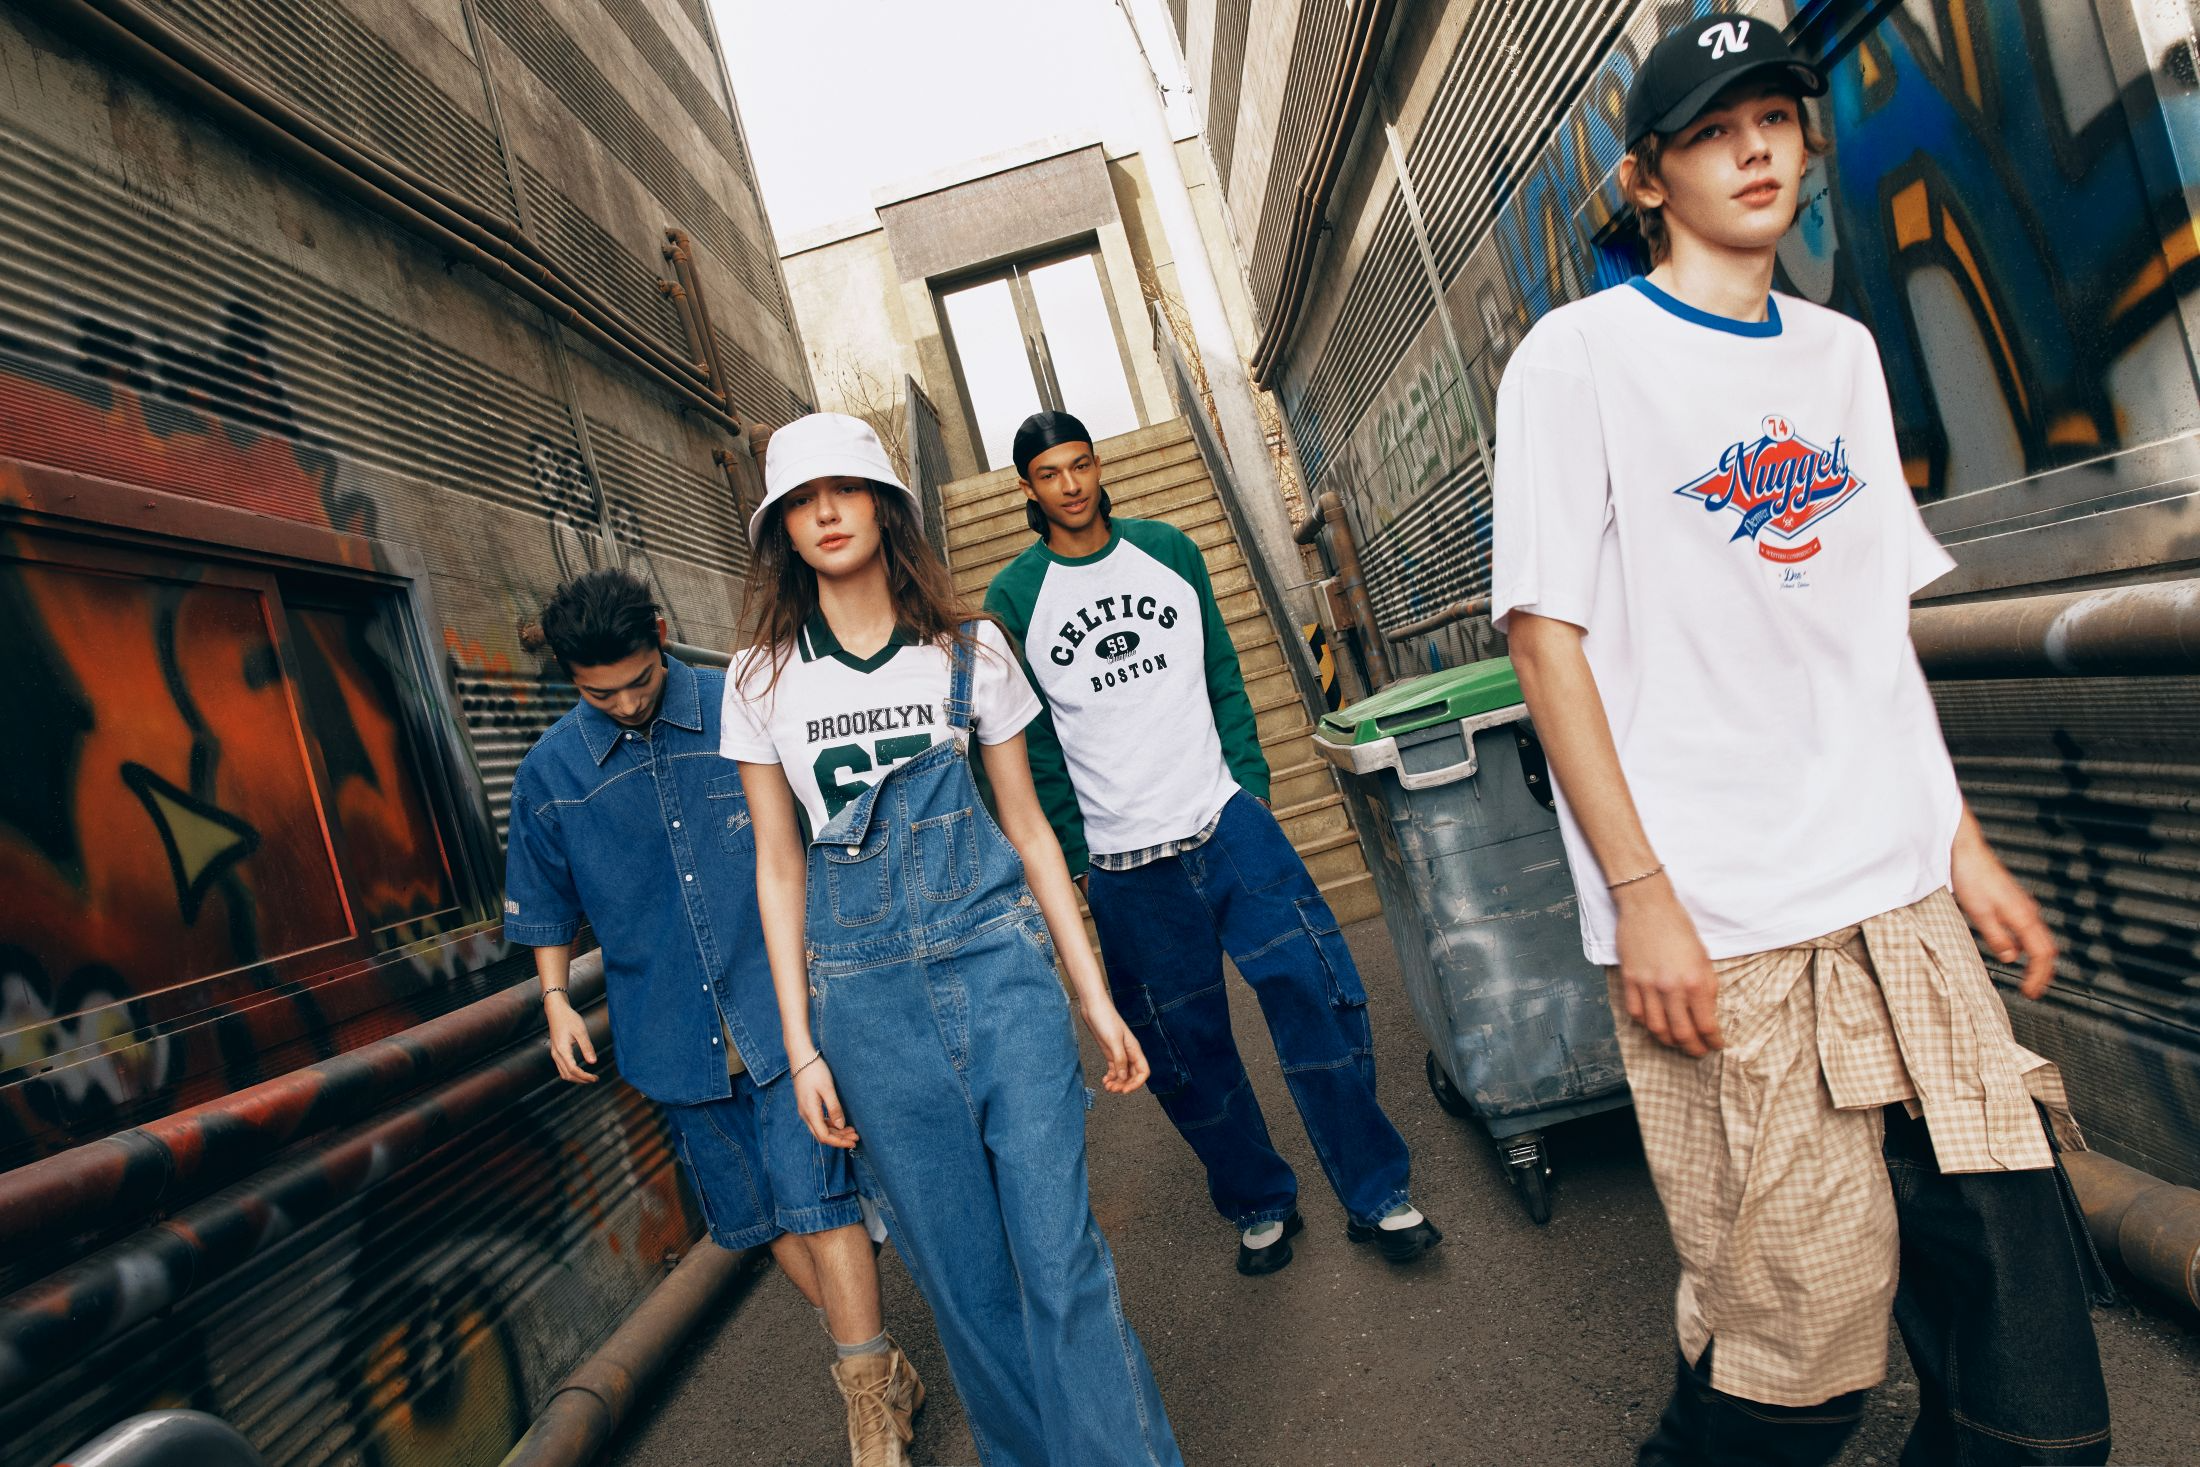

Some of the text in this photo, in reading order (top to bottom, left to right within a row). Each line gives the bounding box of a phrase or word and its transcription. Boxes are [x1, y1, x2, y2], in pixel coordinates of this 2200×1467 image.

[1698, 20, 1750, 60] N
[1768, 419, 1788, 437] 74
[1705, 435, 1850, 512] Nuggets
[1744, 507, 1769, 535] Denver
[1050, 594, 1178, 667] CELTICS
[1106, 635, 1128, 654] 59
[1090, 653, 1168, 693] BOSTON
[806, 704, 935, 744] BROOKLYN
